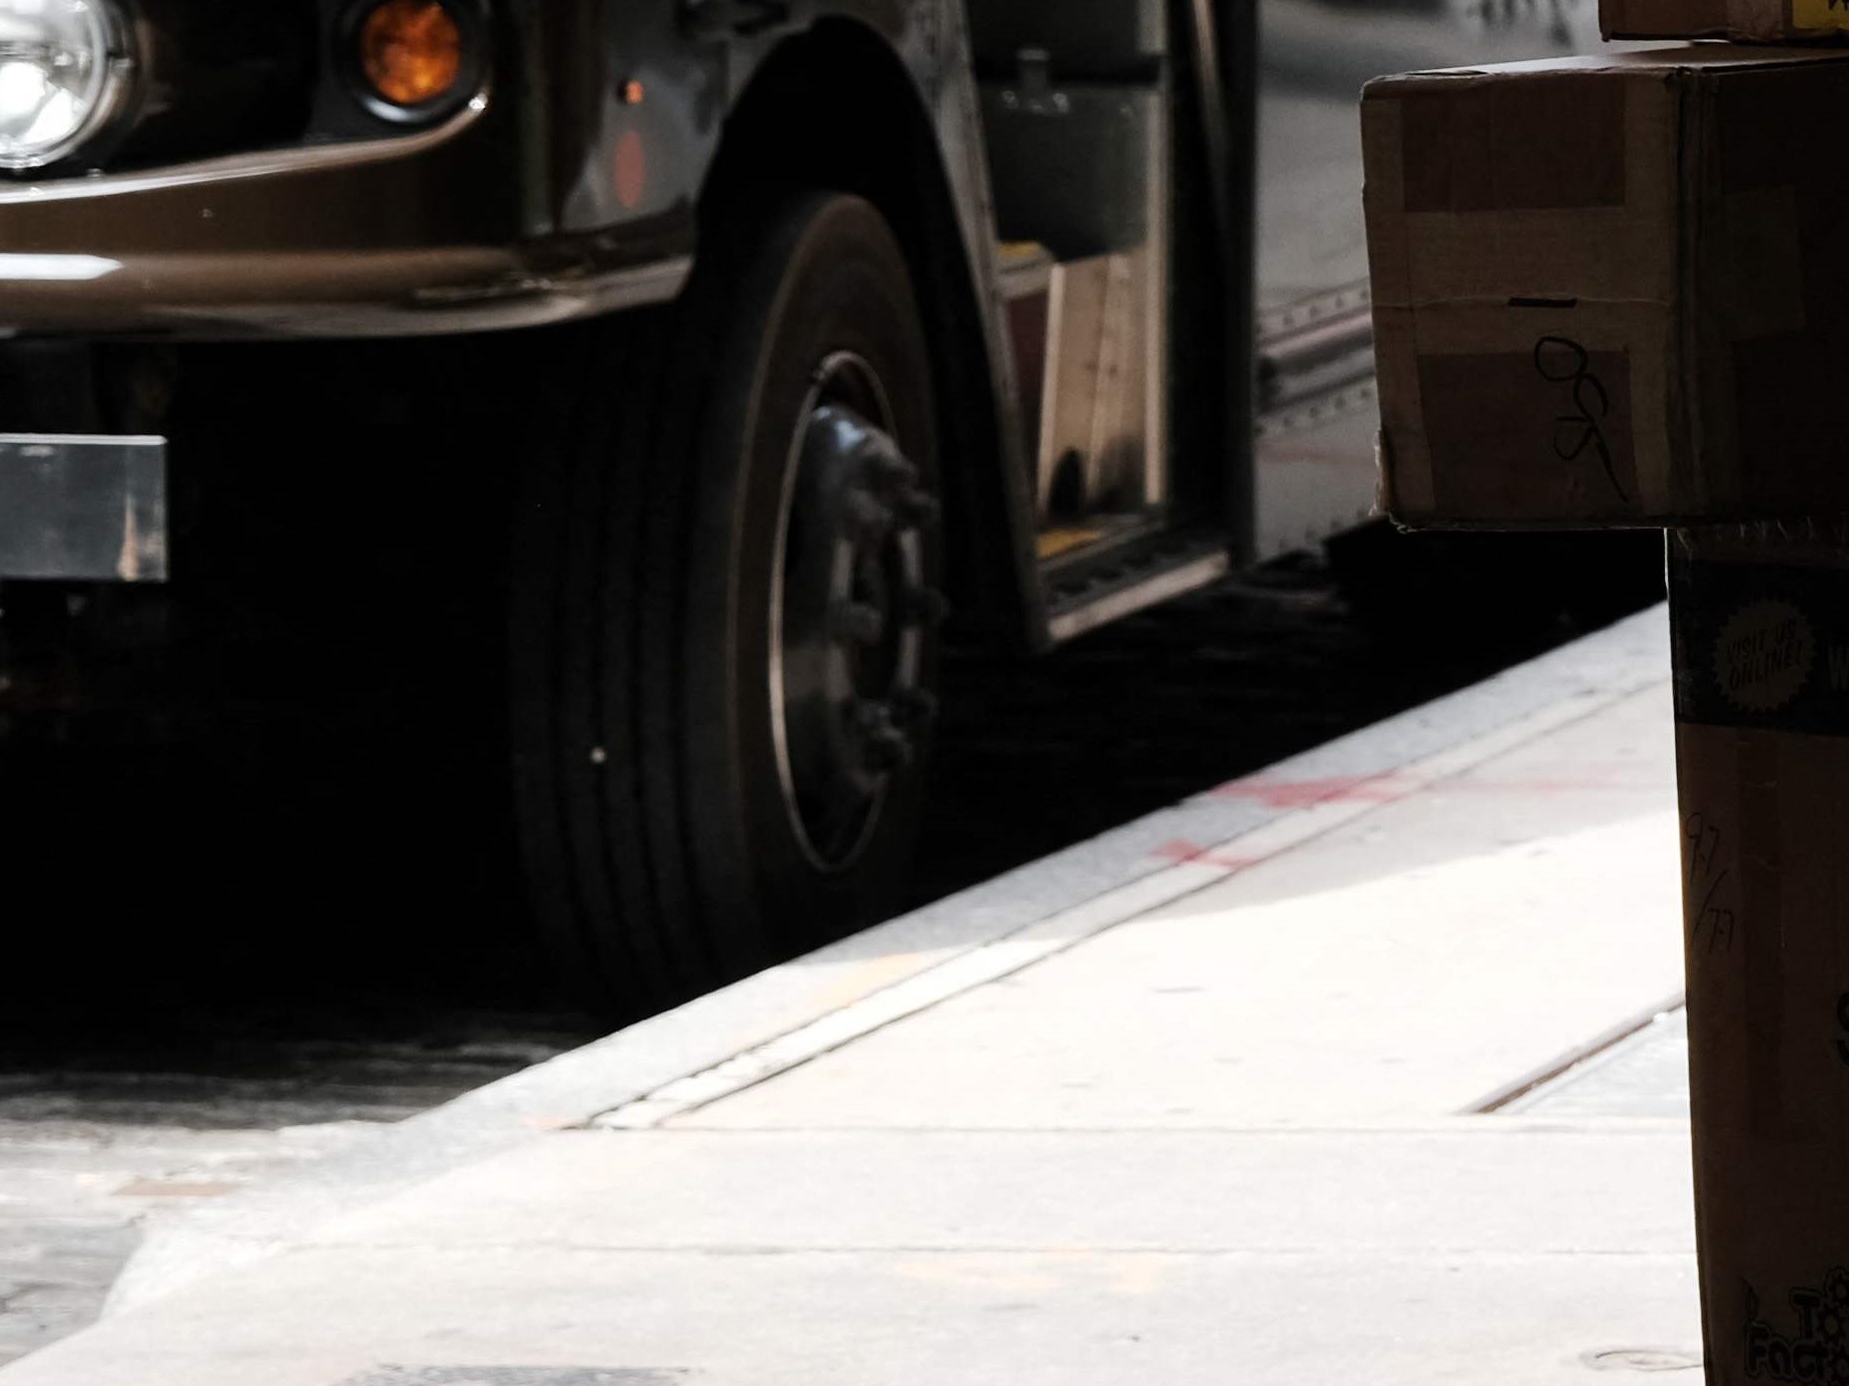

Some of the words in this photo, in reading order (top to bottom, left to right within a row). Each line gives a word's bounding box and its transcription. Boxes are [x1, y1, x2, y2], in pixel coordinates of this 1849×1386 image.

[1727, 629, 1766, 664] VISIT
[1774, 620, 1797, 645] US
[1729, 640, 1803, 691] ONLINE!
